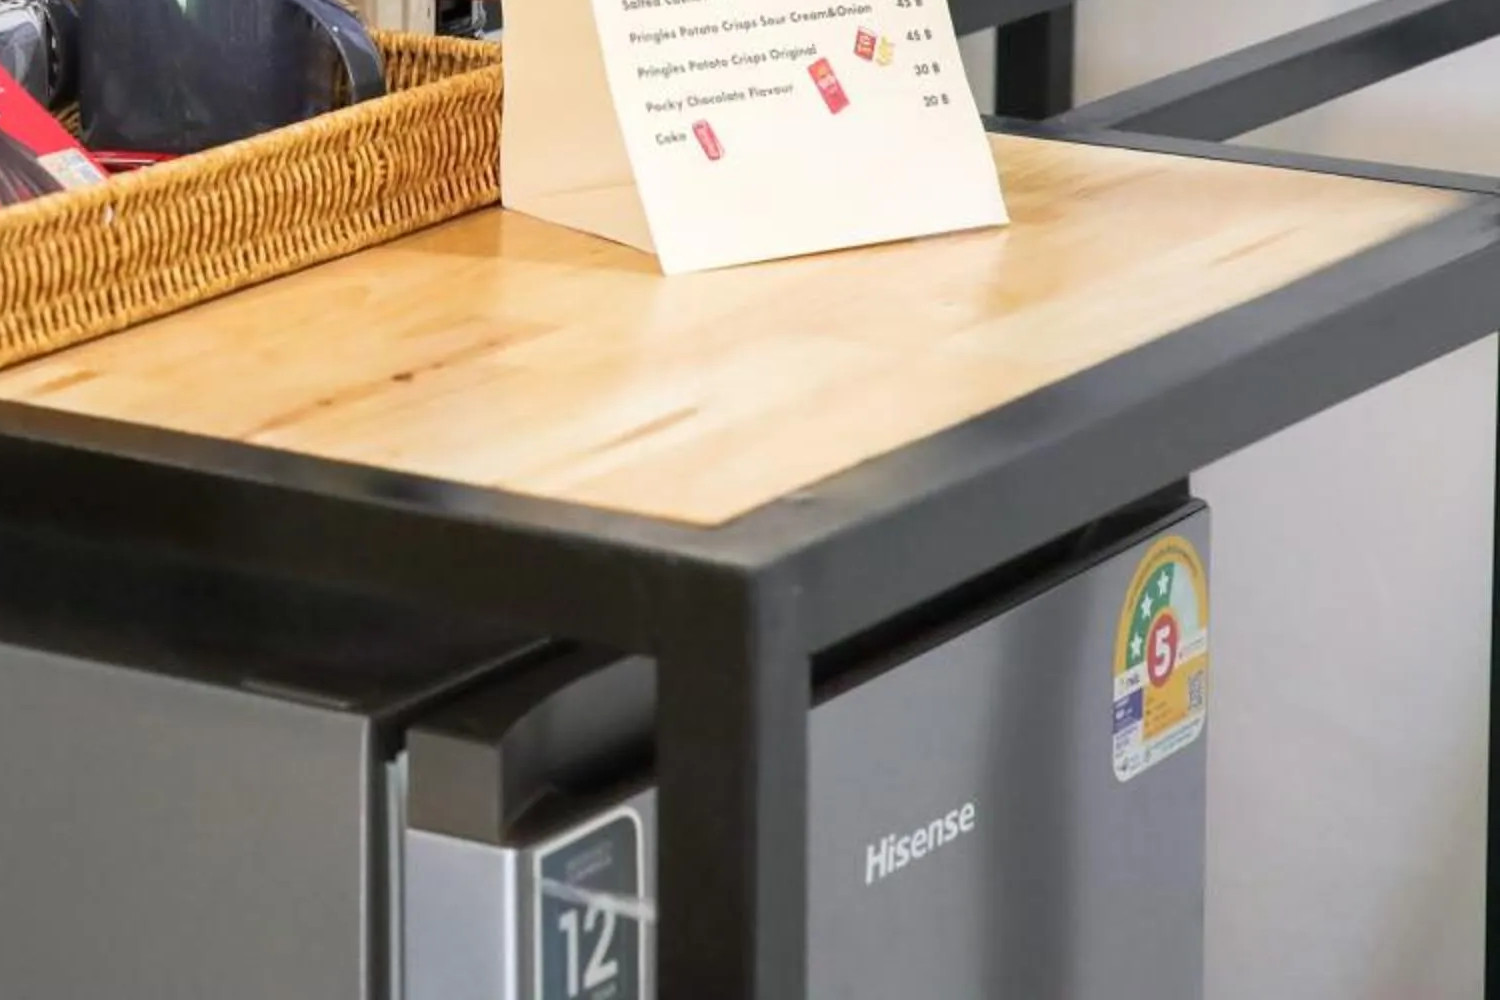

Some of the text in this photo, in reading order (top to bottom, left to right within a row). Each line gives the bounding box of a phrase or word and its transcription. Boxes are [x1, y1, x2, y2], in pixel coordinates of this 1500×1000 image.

[629, 28, 677, 45] Pringles
[721, 18, 758, 33] Crisps
[759, 15, 786, 27] Sour
[637, 62, 686, 79] Pringles
[731, 53, 767, 68] Crisps
[769, 43, 817, 60] Original
[645, 99, 683, 113] Pocky
[1153, 623, 1172, 678] 5
[865, 802, 975, 885] Hisense
[558, 892, 618, 998] 12
